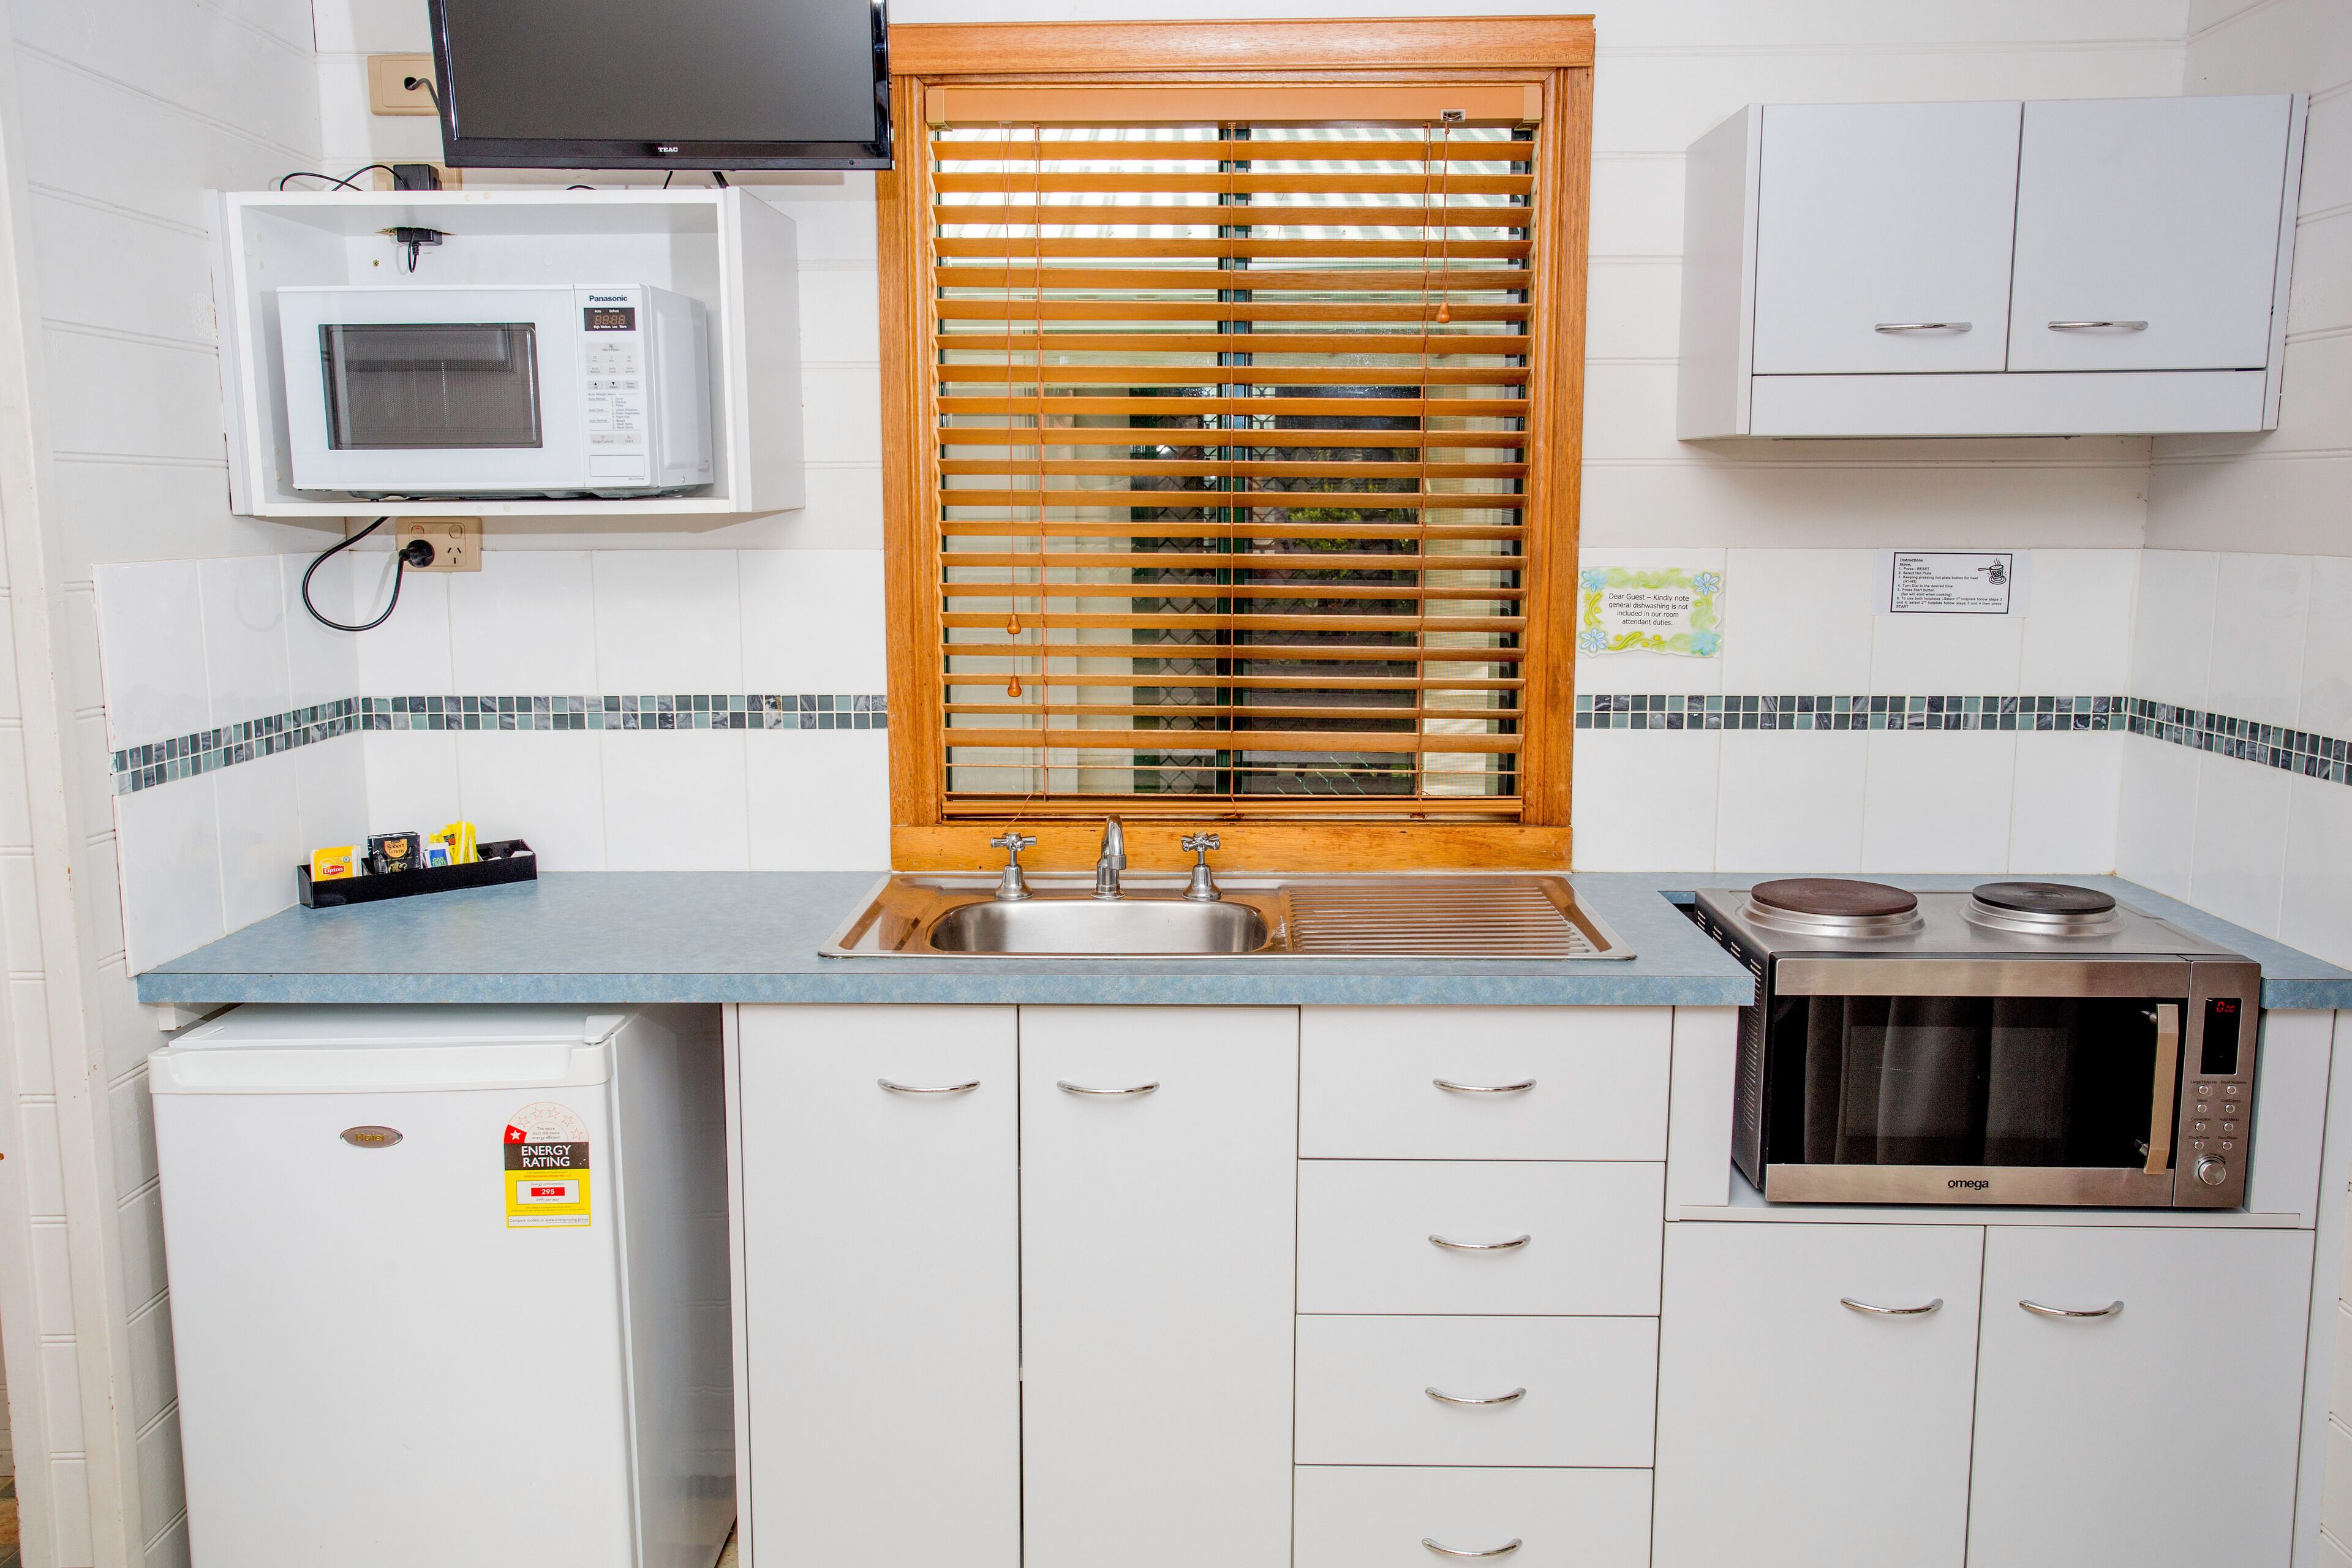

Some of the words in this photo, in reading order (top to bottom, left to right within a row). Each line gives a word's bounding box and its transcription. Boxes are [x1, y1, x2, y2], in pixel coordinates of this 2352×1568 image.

[355, 1132, 386, 1142] Haier
[521, 1145, 571, 1156] ENERGY
[523, 1156, 570, 1167] RATING
[1948, 1180, 1989, 1190] omega
